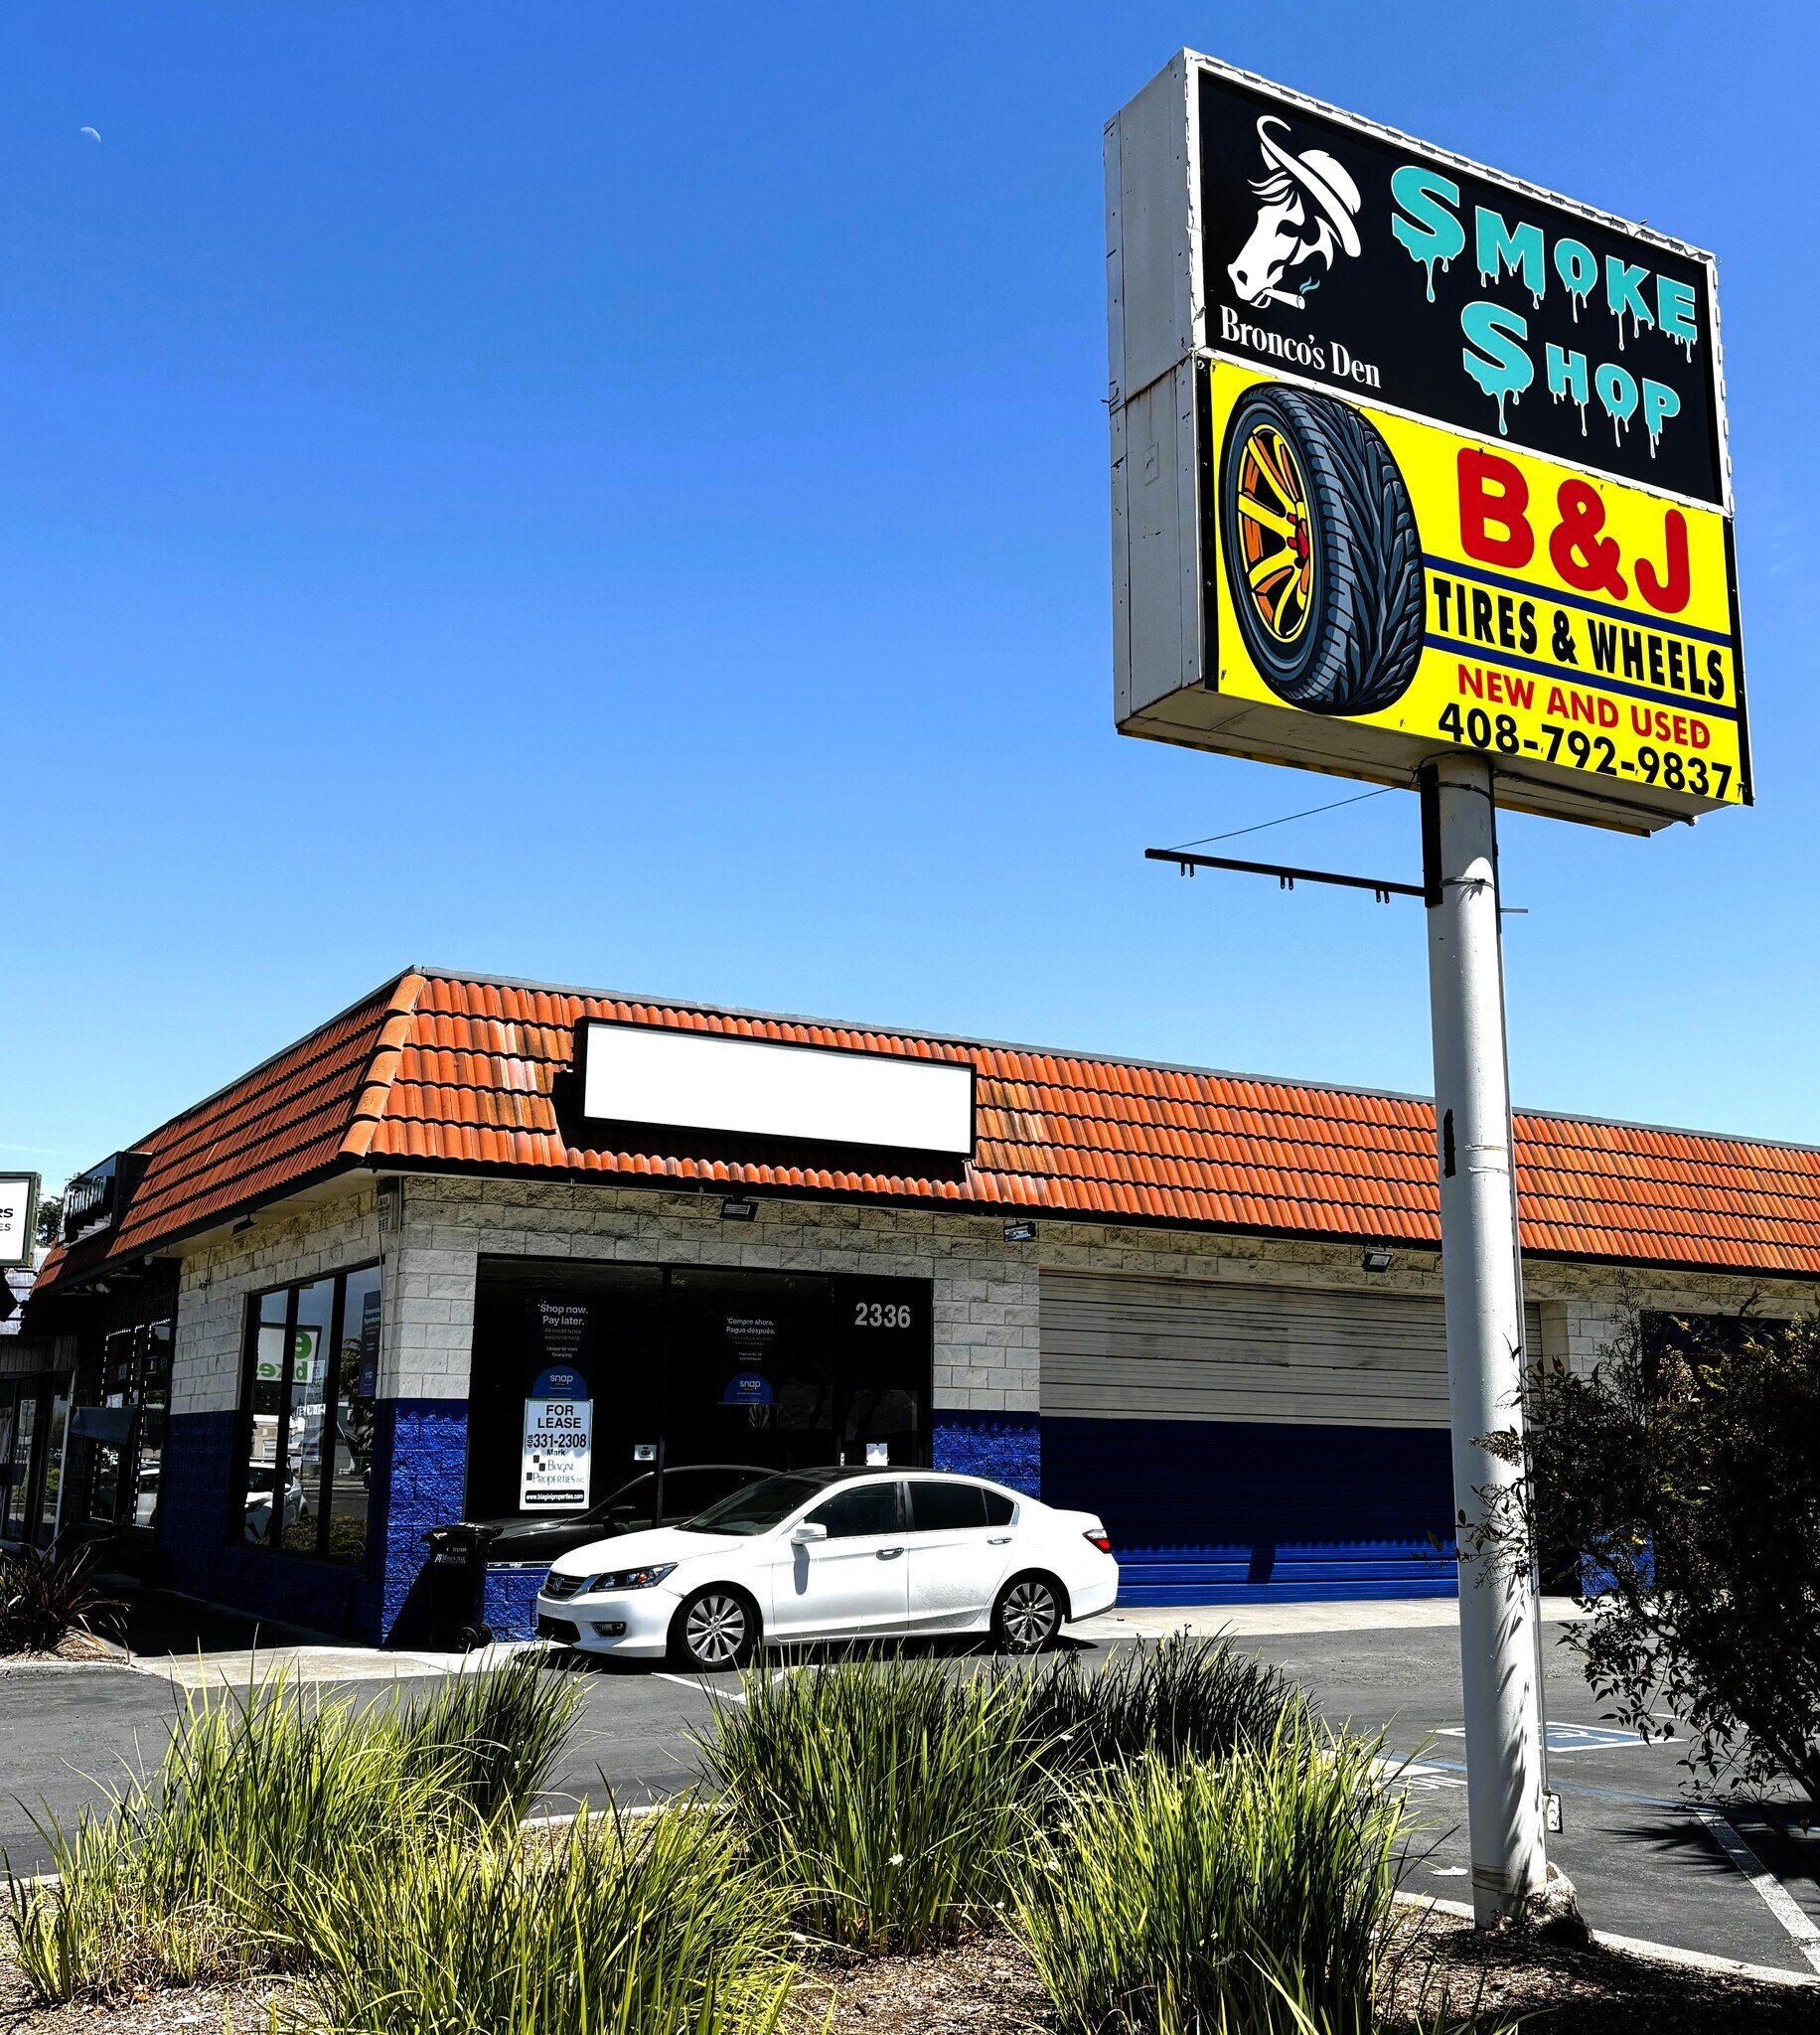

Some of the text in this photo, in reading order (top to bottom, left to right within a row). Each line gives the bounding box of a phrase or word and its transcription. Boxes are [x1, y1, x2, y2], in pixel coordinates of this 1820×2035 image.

[1391, 165, 1698, 363] SMOKE
[1219, 304, 1382, 389] Bronco's Den
[1460, 301, 1681, 458] SHOP
[1433, 577, 1725, 701] TIRES & WHEELS
[1457, 664, 1711, 749] NEW AND USED
[1439, 703, 1733, 799] 408-792-9837
[539, 1304, 564, 1315] Shop
[854, 1302, 911, 1329] 2336
[542, 1316, 585, 1326] Pay later.
[549, 1374, 573, 1384] snap
[739, 1380, 761, 1390] snap
[545, 1405, 574, 1416] FOR
[537, 1417, 582, 1429] LEASE
[533, 1433, 587, 1448] 331-2308
